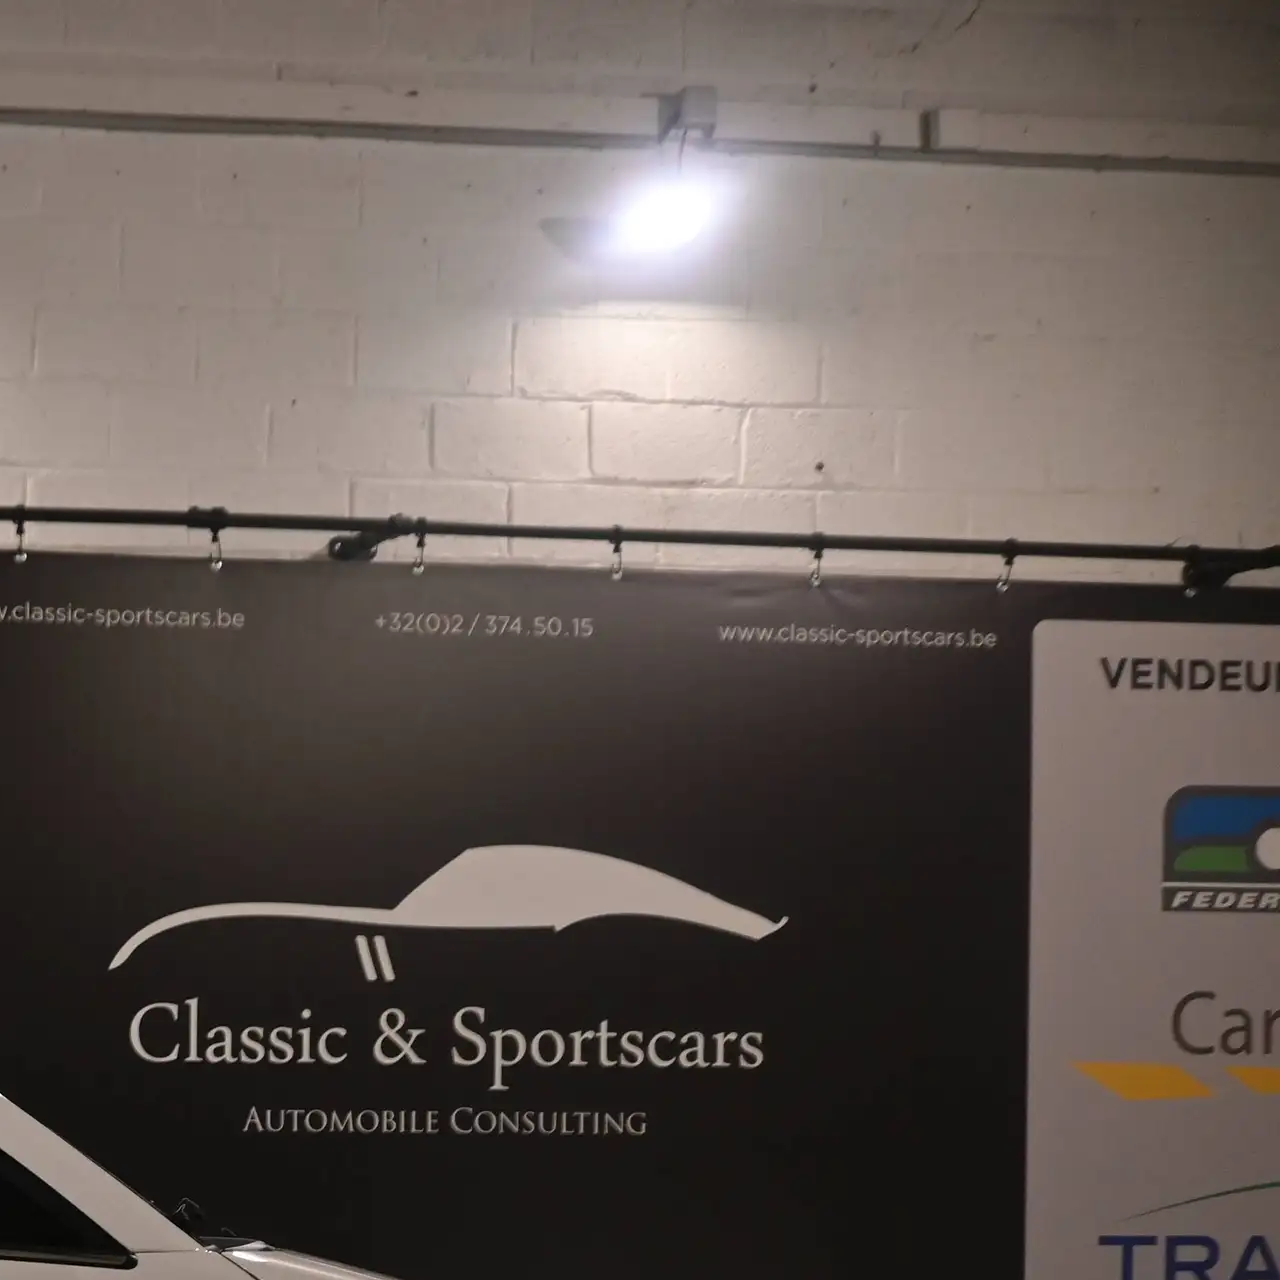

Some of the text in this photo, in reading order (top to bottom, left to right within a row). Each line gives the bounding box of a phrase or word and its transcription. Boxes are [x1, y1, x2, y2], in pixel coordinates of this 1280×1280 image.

[718, 623, 998, 649] www.classic-sportscars.be
[1100, 656, 1280, 692] VENDEU
[128, 997, 765, 1091] Classic & Sportscars
[242, 1105, 647, 1137] AUTOMOBILE CONSULTING
